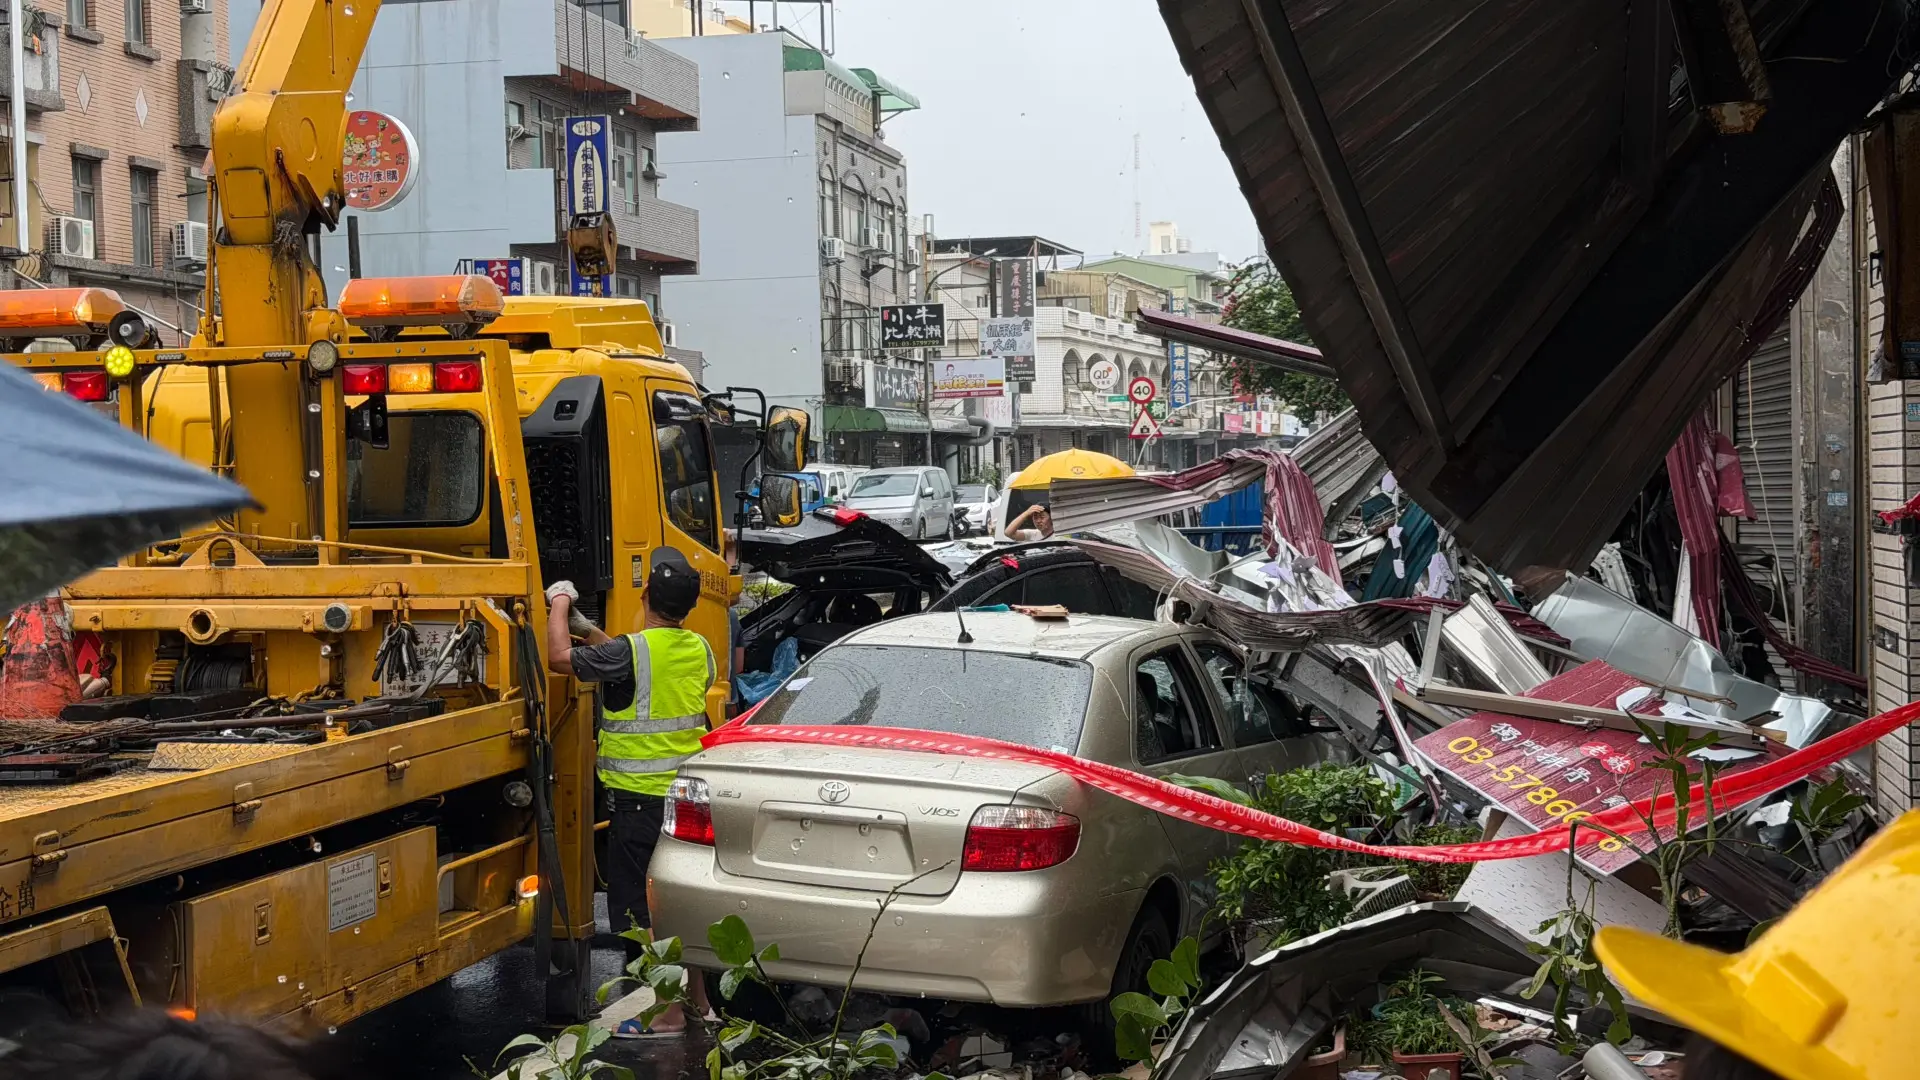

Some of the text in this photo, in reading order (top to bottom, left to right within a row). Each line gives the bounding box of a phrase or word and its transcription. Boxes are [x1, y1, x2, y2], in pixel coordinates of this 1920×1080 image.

[892, 305, 937, 325] 小牛
[884, 324, 942, 340] 比較懶
[1134, 385, 1151, 396] 40
[917, 804, 961, 818] VIOS
